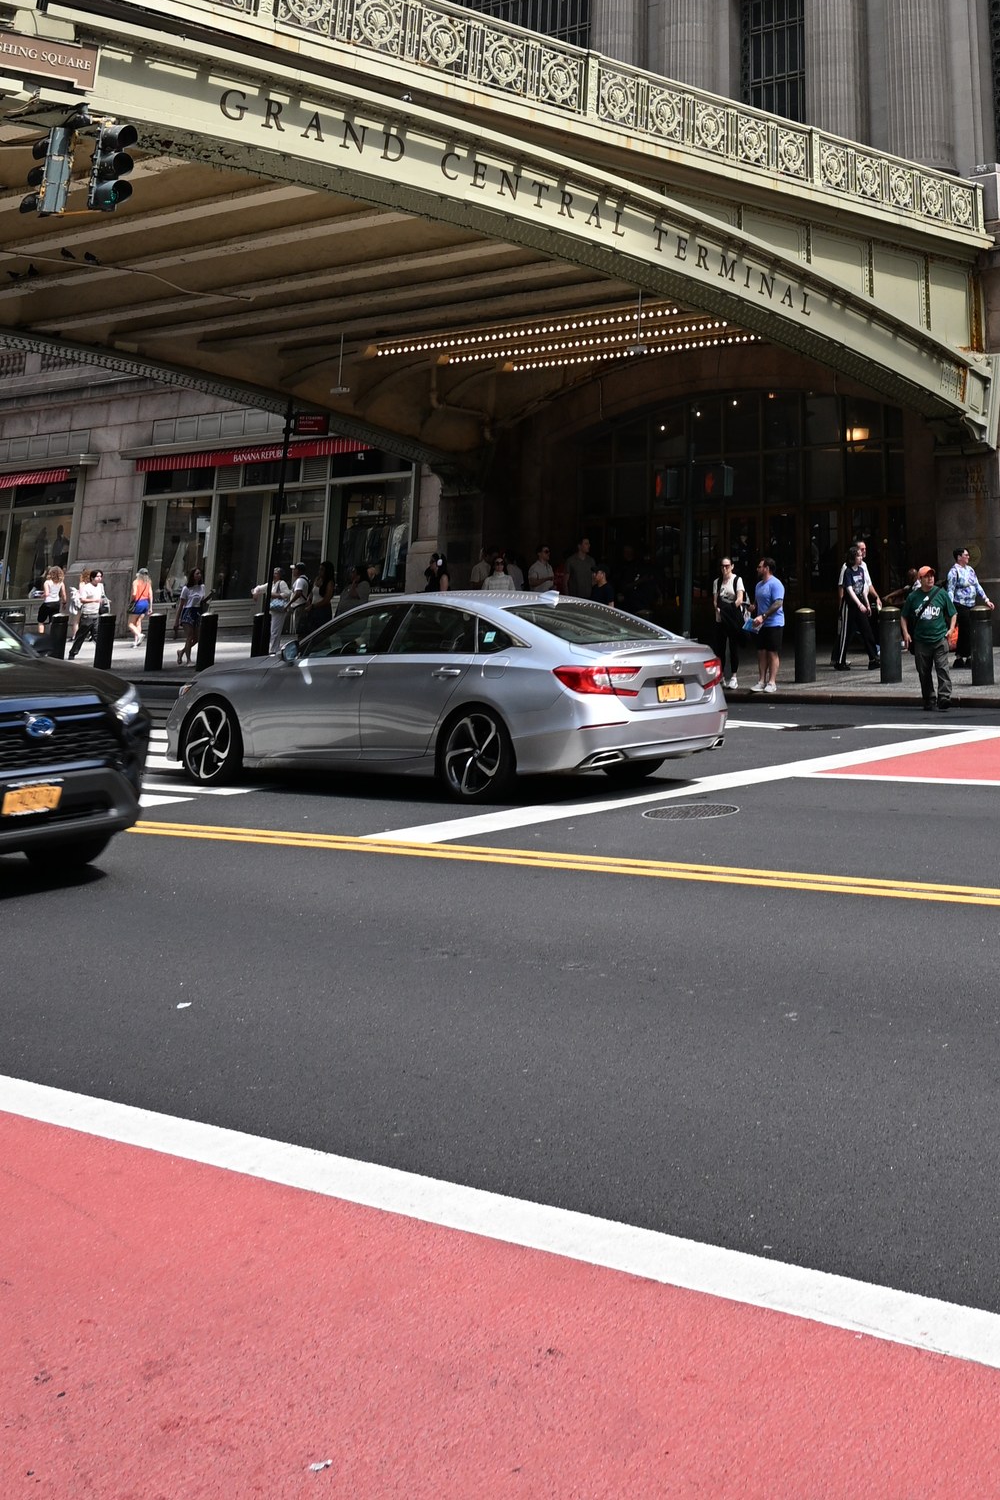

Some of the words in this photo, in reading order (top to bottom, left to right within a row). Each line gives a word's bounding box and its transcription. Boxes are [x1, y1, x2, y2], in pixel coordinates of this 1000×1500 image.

[41, 51, 92, 70] SQUARE
[219, 88, 405, 162] GRAND
[440, 152, 626, 238] CENTRAL
[653, 225, 812, 317] TERMINAL
[233, 452, 260, 463] BANANA
[260, 448, 293, 460] REPUBLC
